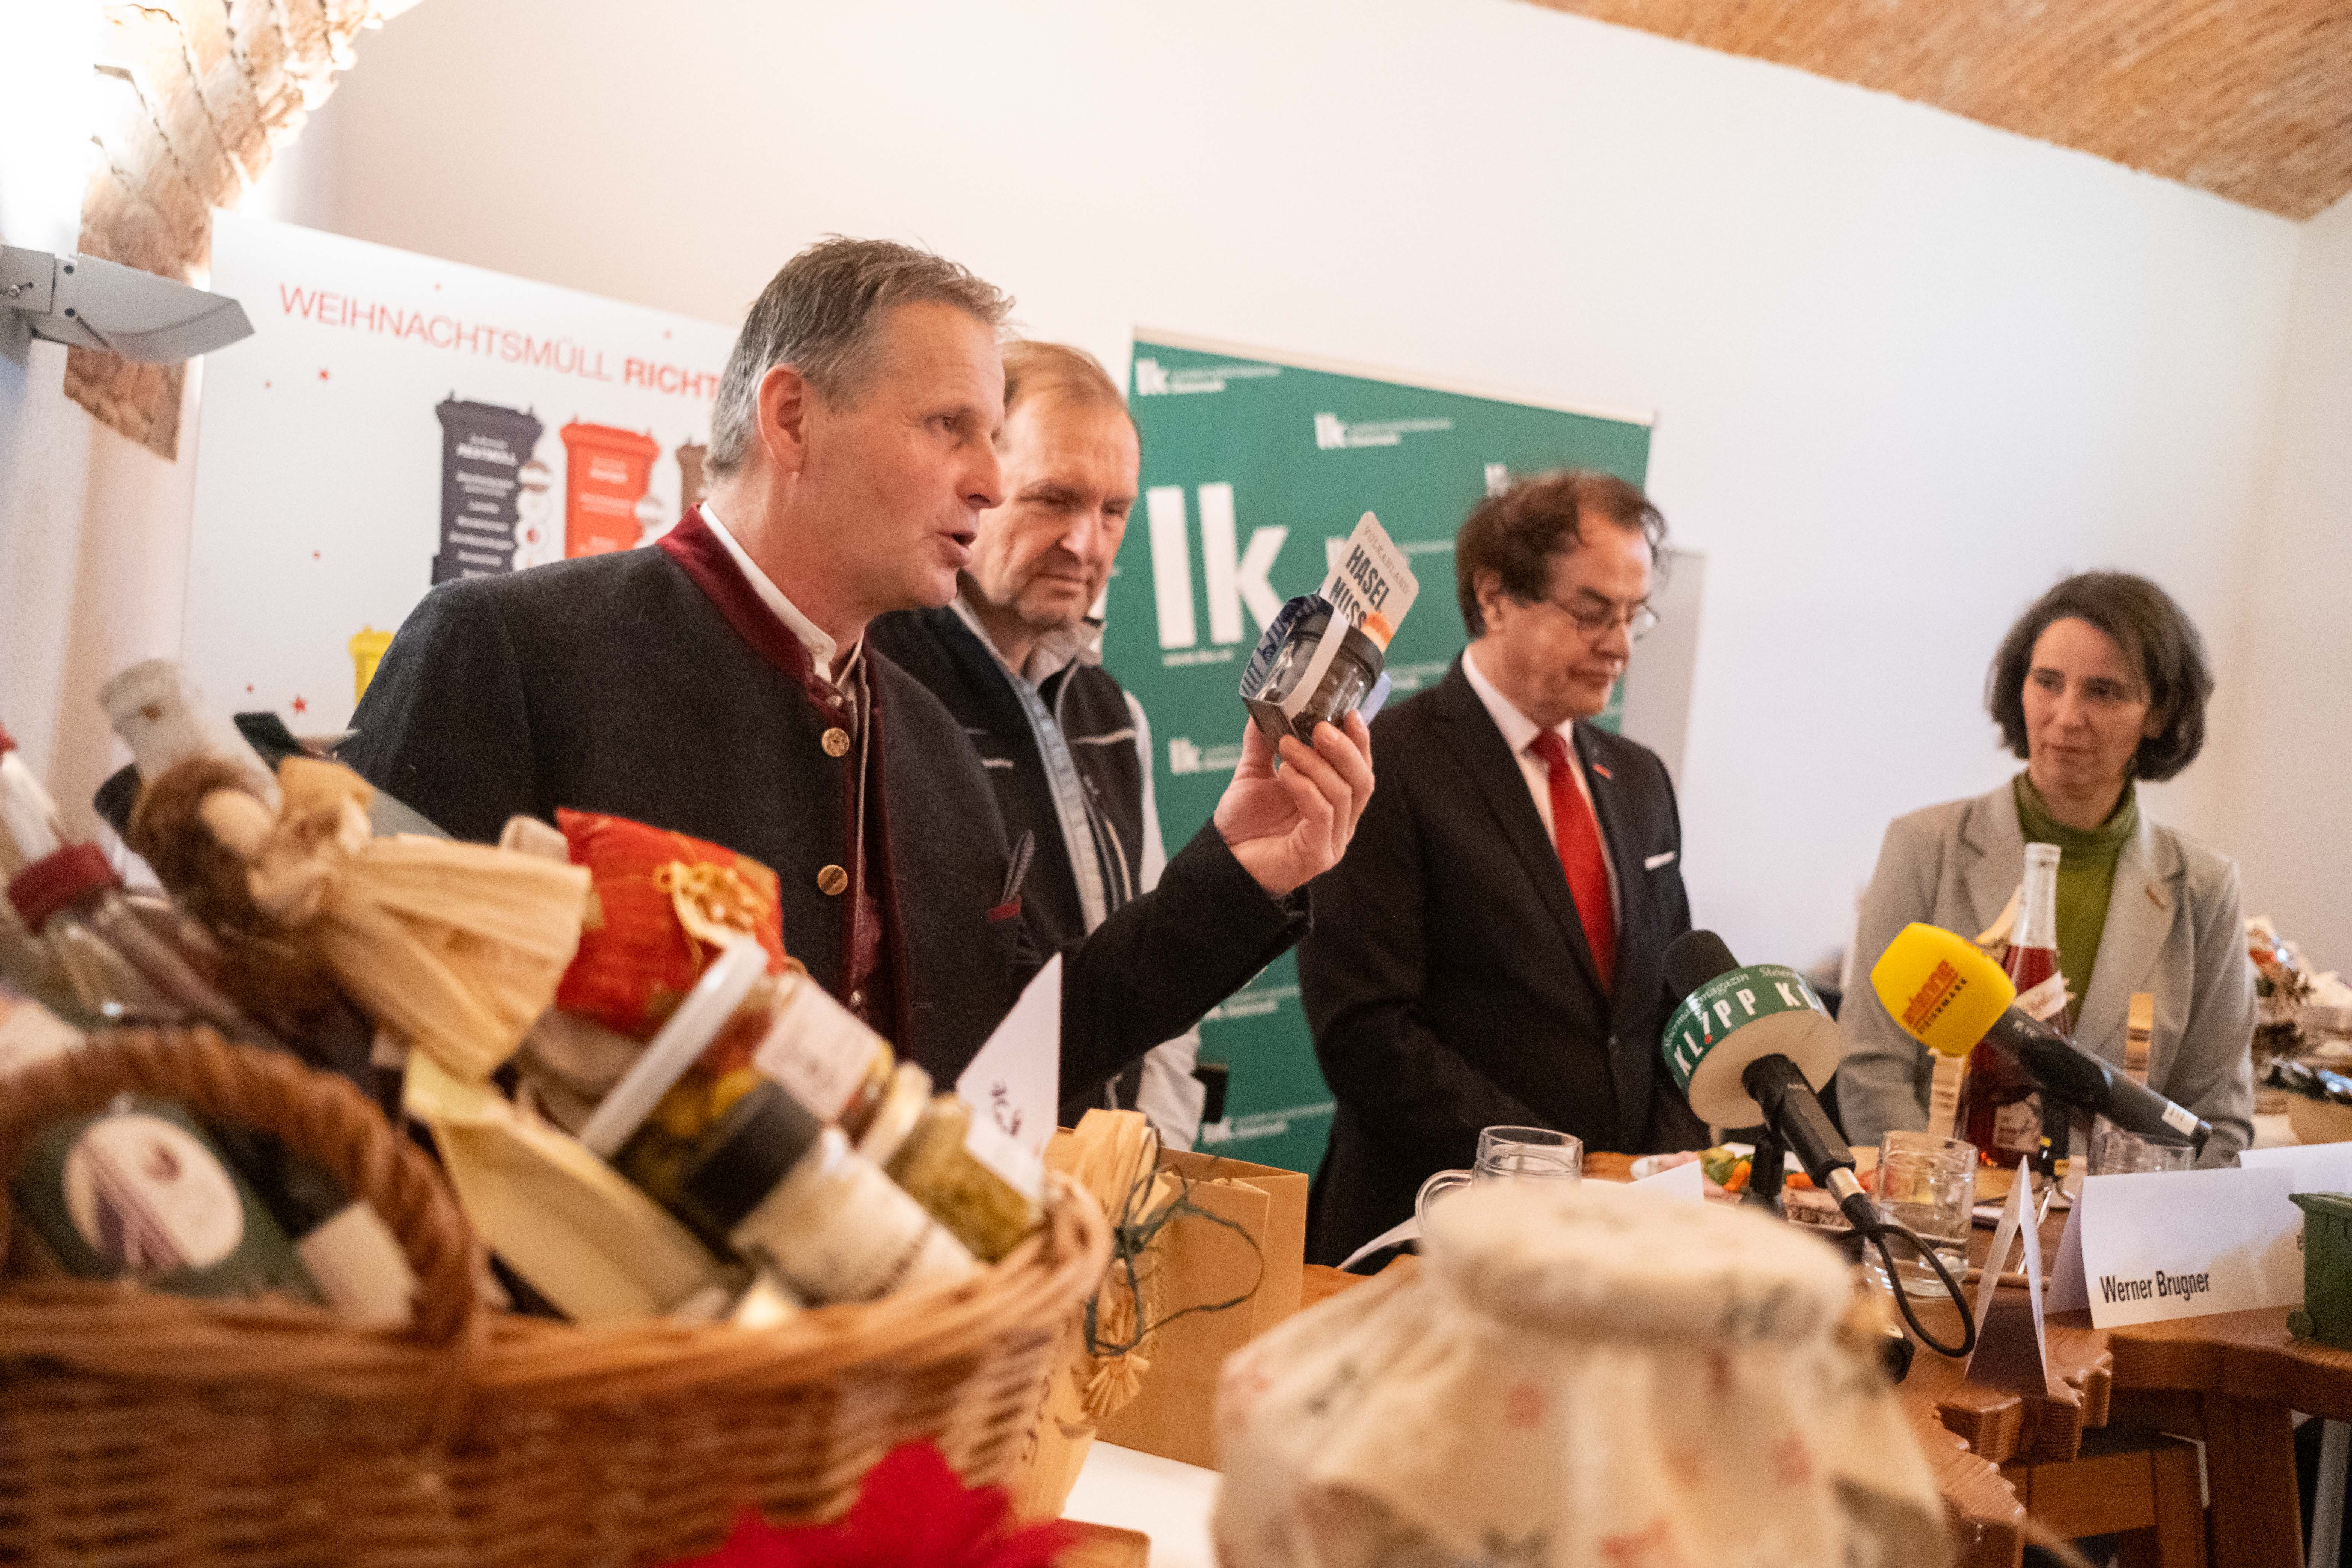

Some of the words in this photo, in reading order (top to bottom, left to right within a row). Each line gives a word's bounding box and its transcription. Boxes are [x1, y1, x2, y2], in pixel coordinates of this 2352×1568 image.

[280, 283, 612, 381] WEIHNACHTSMÜLL
[1146, 482, 1289, 650] lk
[2099, 1275, 2153, 1303] Werner
[2155, 1270, 2210, 1301] Brugner
